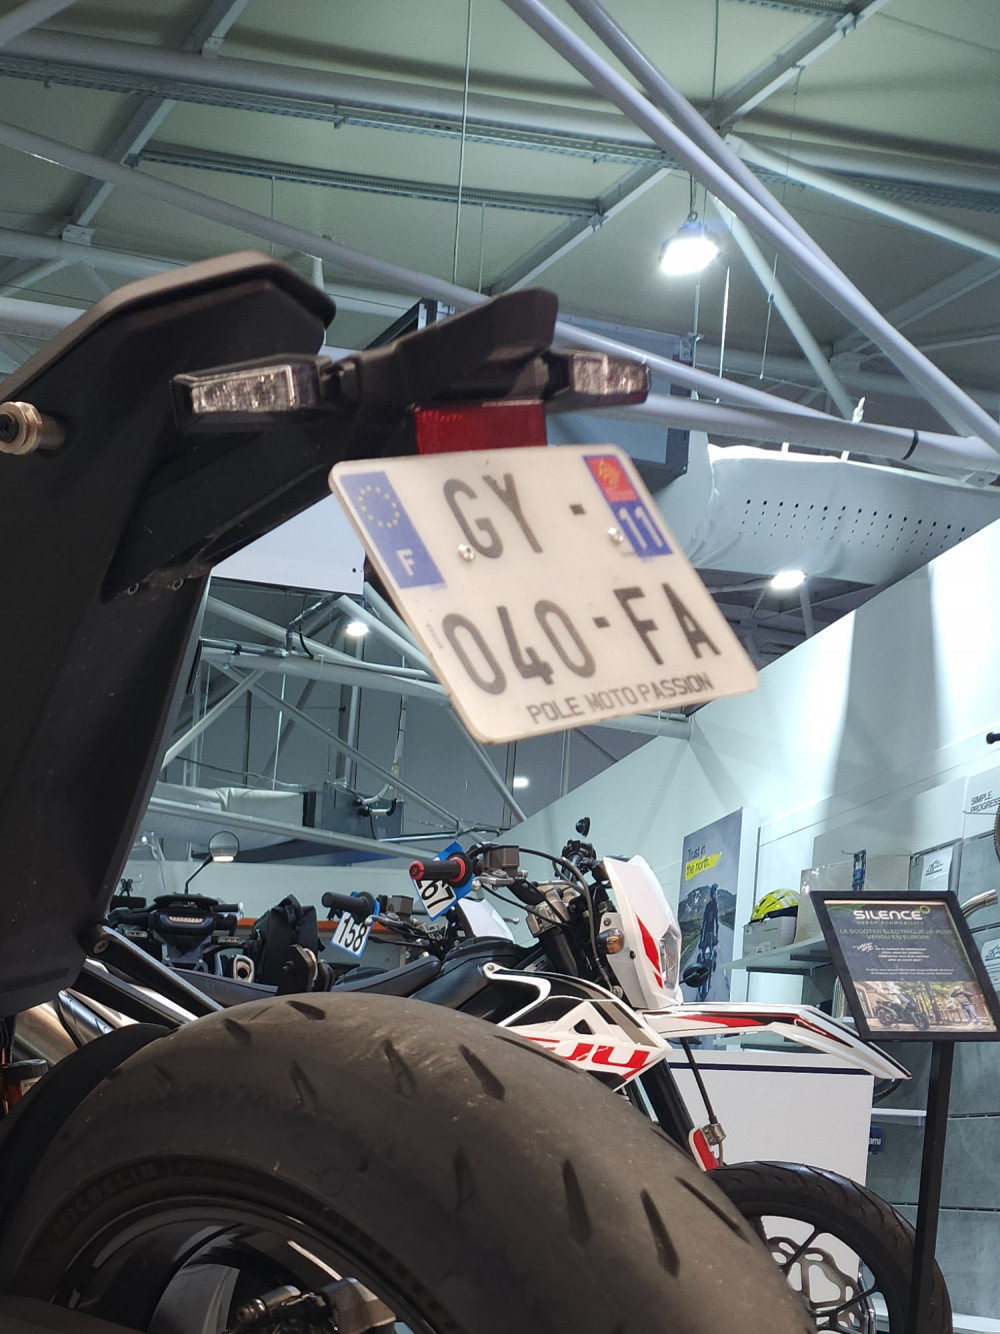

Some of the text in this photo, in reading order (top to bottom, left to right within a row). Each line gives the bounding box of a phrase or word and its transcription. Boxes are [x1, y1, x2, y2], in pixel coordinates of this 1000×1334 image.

[618, 507, 662, 551] 11
[397, 548, 415, 578] F
[441, 582, 721, 696] 040-FA
[526, 673, 714, 725] POLE MOTO PASSION
[338, 915, 368, 952] 158
[853, 909, 923, 921] SILENCE
[50, 1161, 159, 1239] MICHELIN
